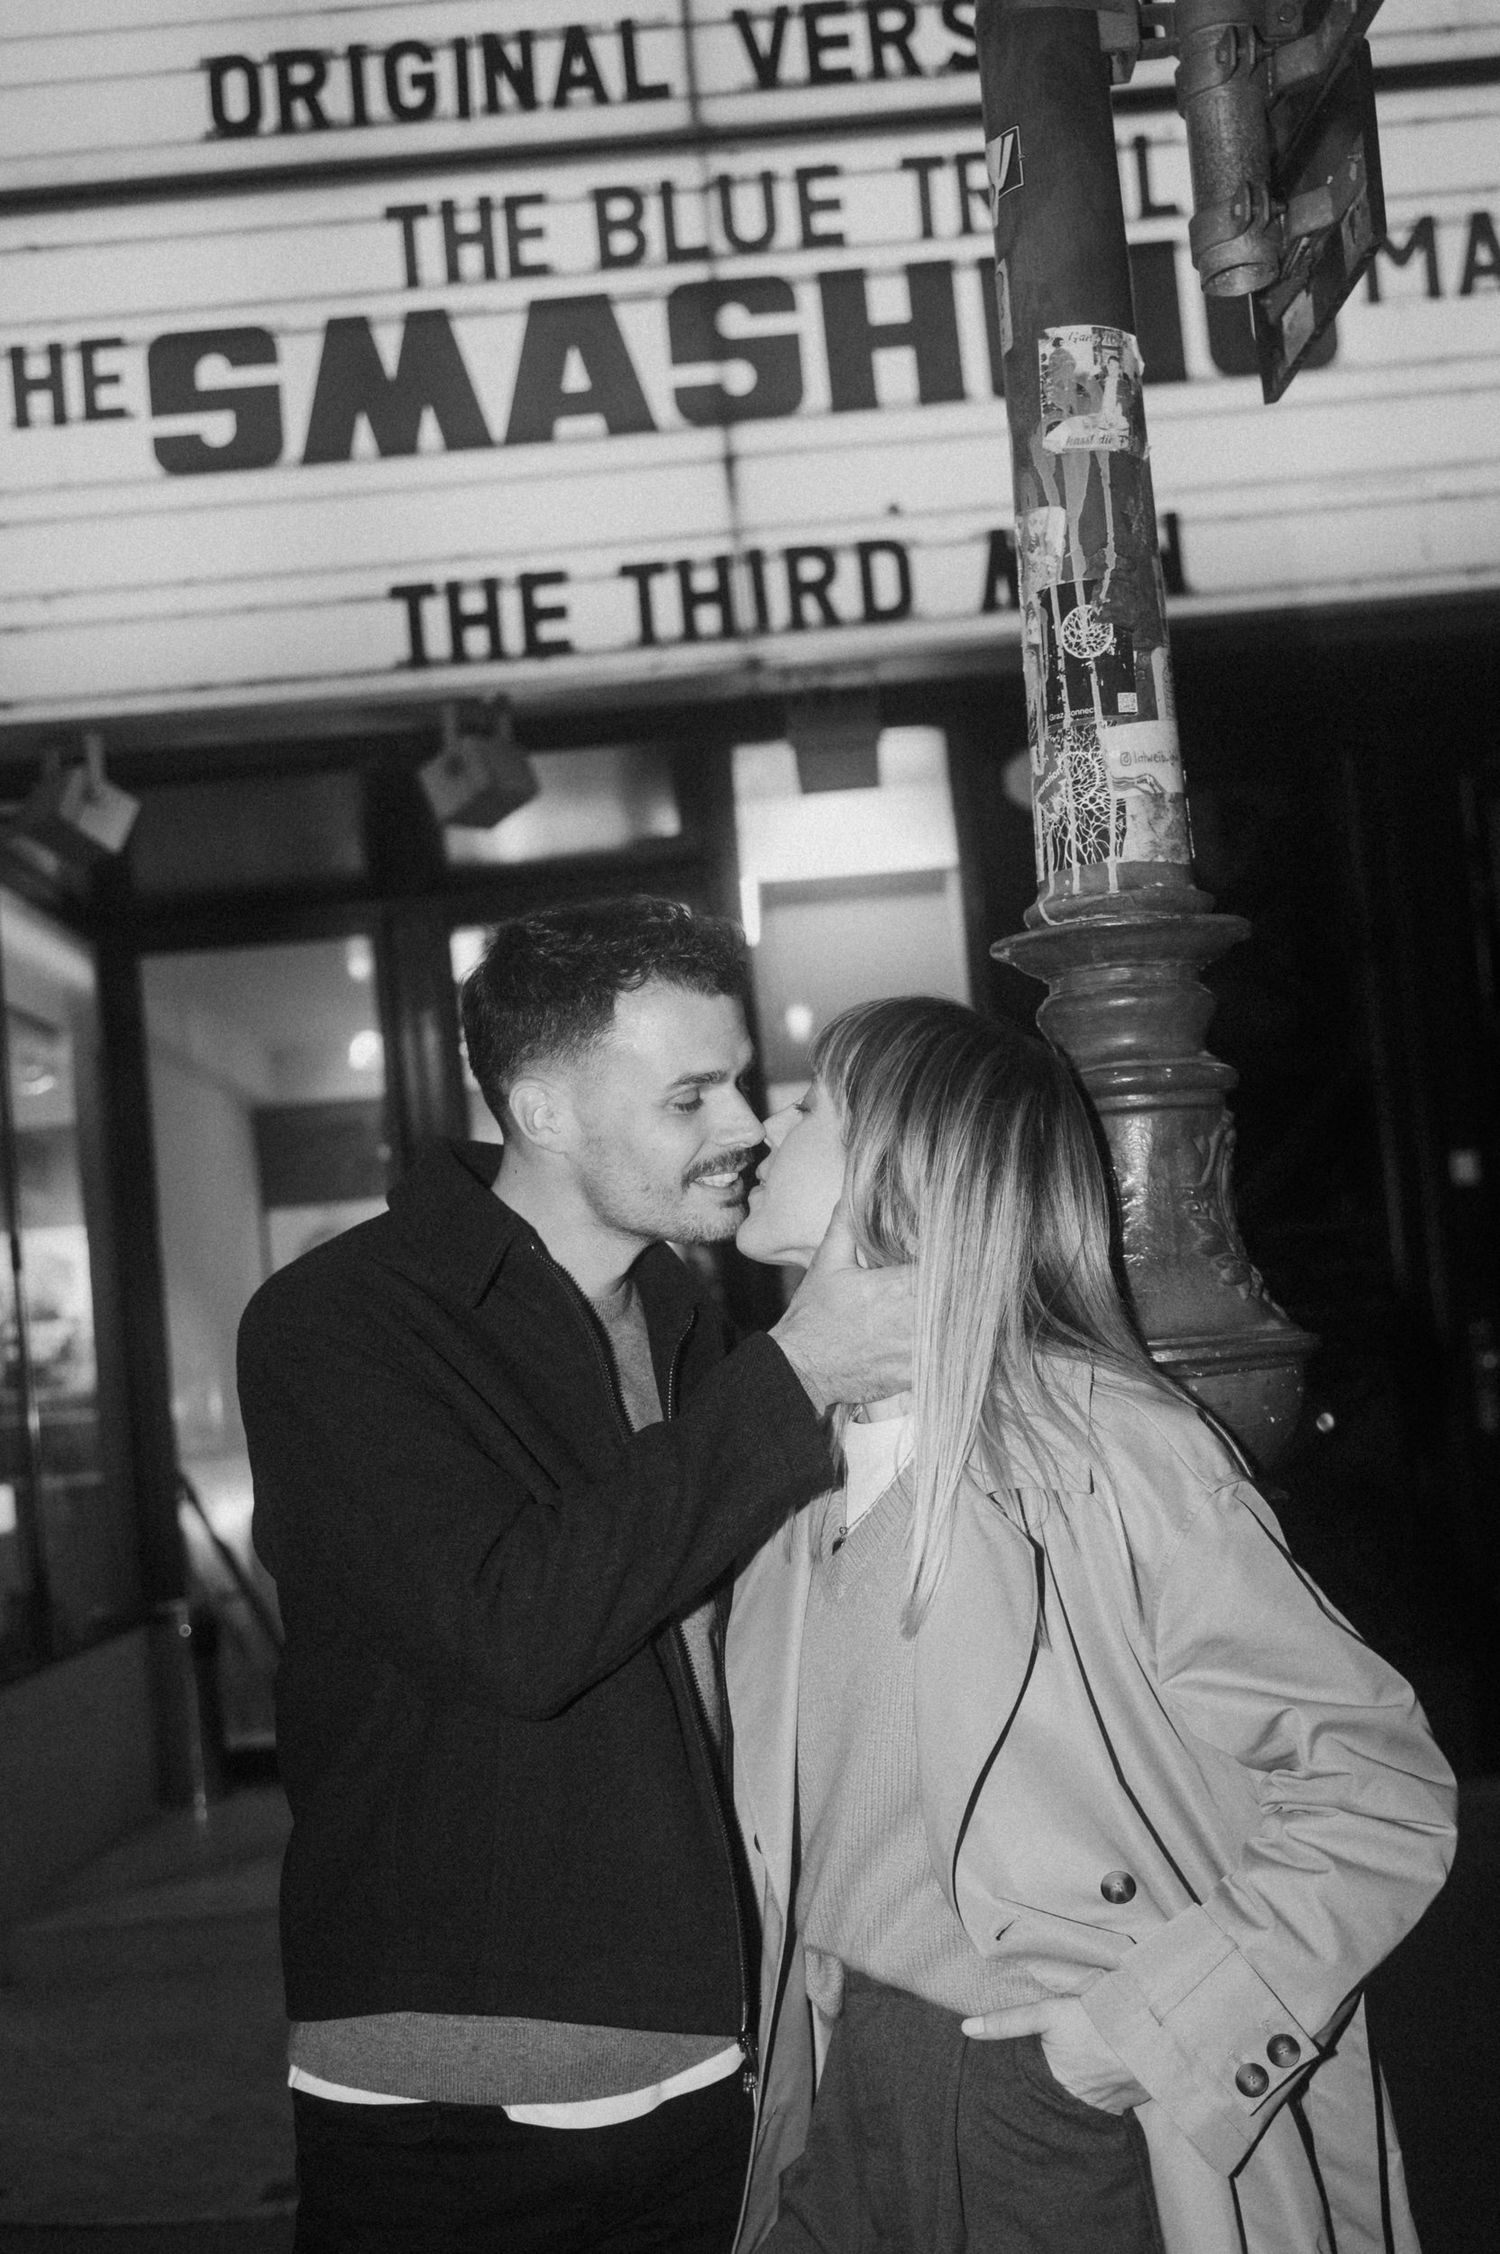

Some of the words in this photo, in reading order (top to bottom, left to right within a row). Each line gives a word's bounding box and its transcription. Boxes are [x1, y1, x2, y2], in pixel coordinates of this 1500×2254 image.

[204, 18, 670, 139] ORIGINAL
[385, 194, 552, 288] THE
[594, 165, 846, 269] BLUE
[902, 136, 1180, 238] TRL
[390, 571, 573, 668] THE
[620, 540, 911, 646] THIRD
